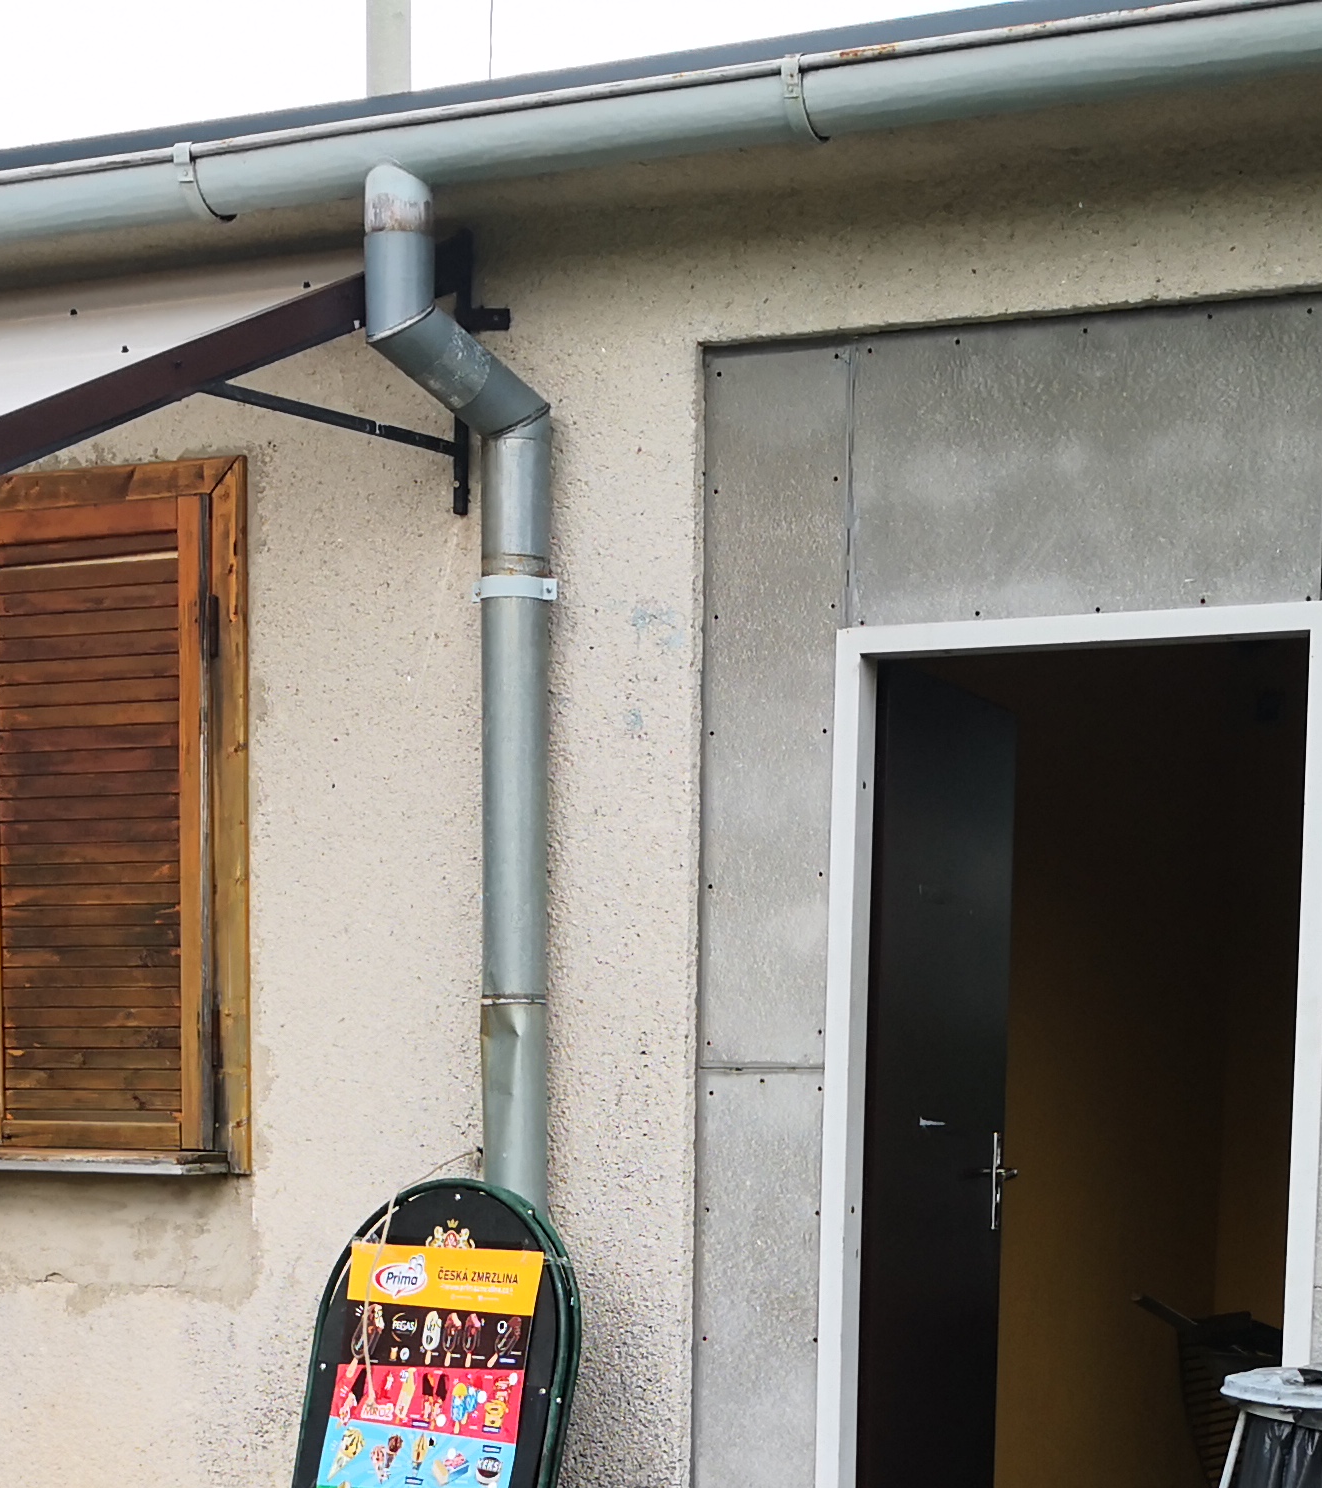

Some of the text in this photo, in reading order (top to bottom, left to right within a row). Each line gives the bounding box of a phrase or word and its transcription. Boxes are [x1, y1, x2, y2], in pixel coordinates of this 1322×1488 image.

[385, 1271, 418, 1286] Prima
[437, 1267, 519, 1284] ČESKÁ ZMRZLINA
[392, 1320, 416, 1331] PEGAS
